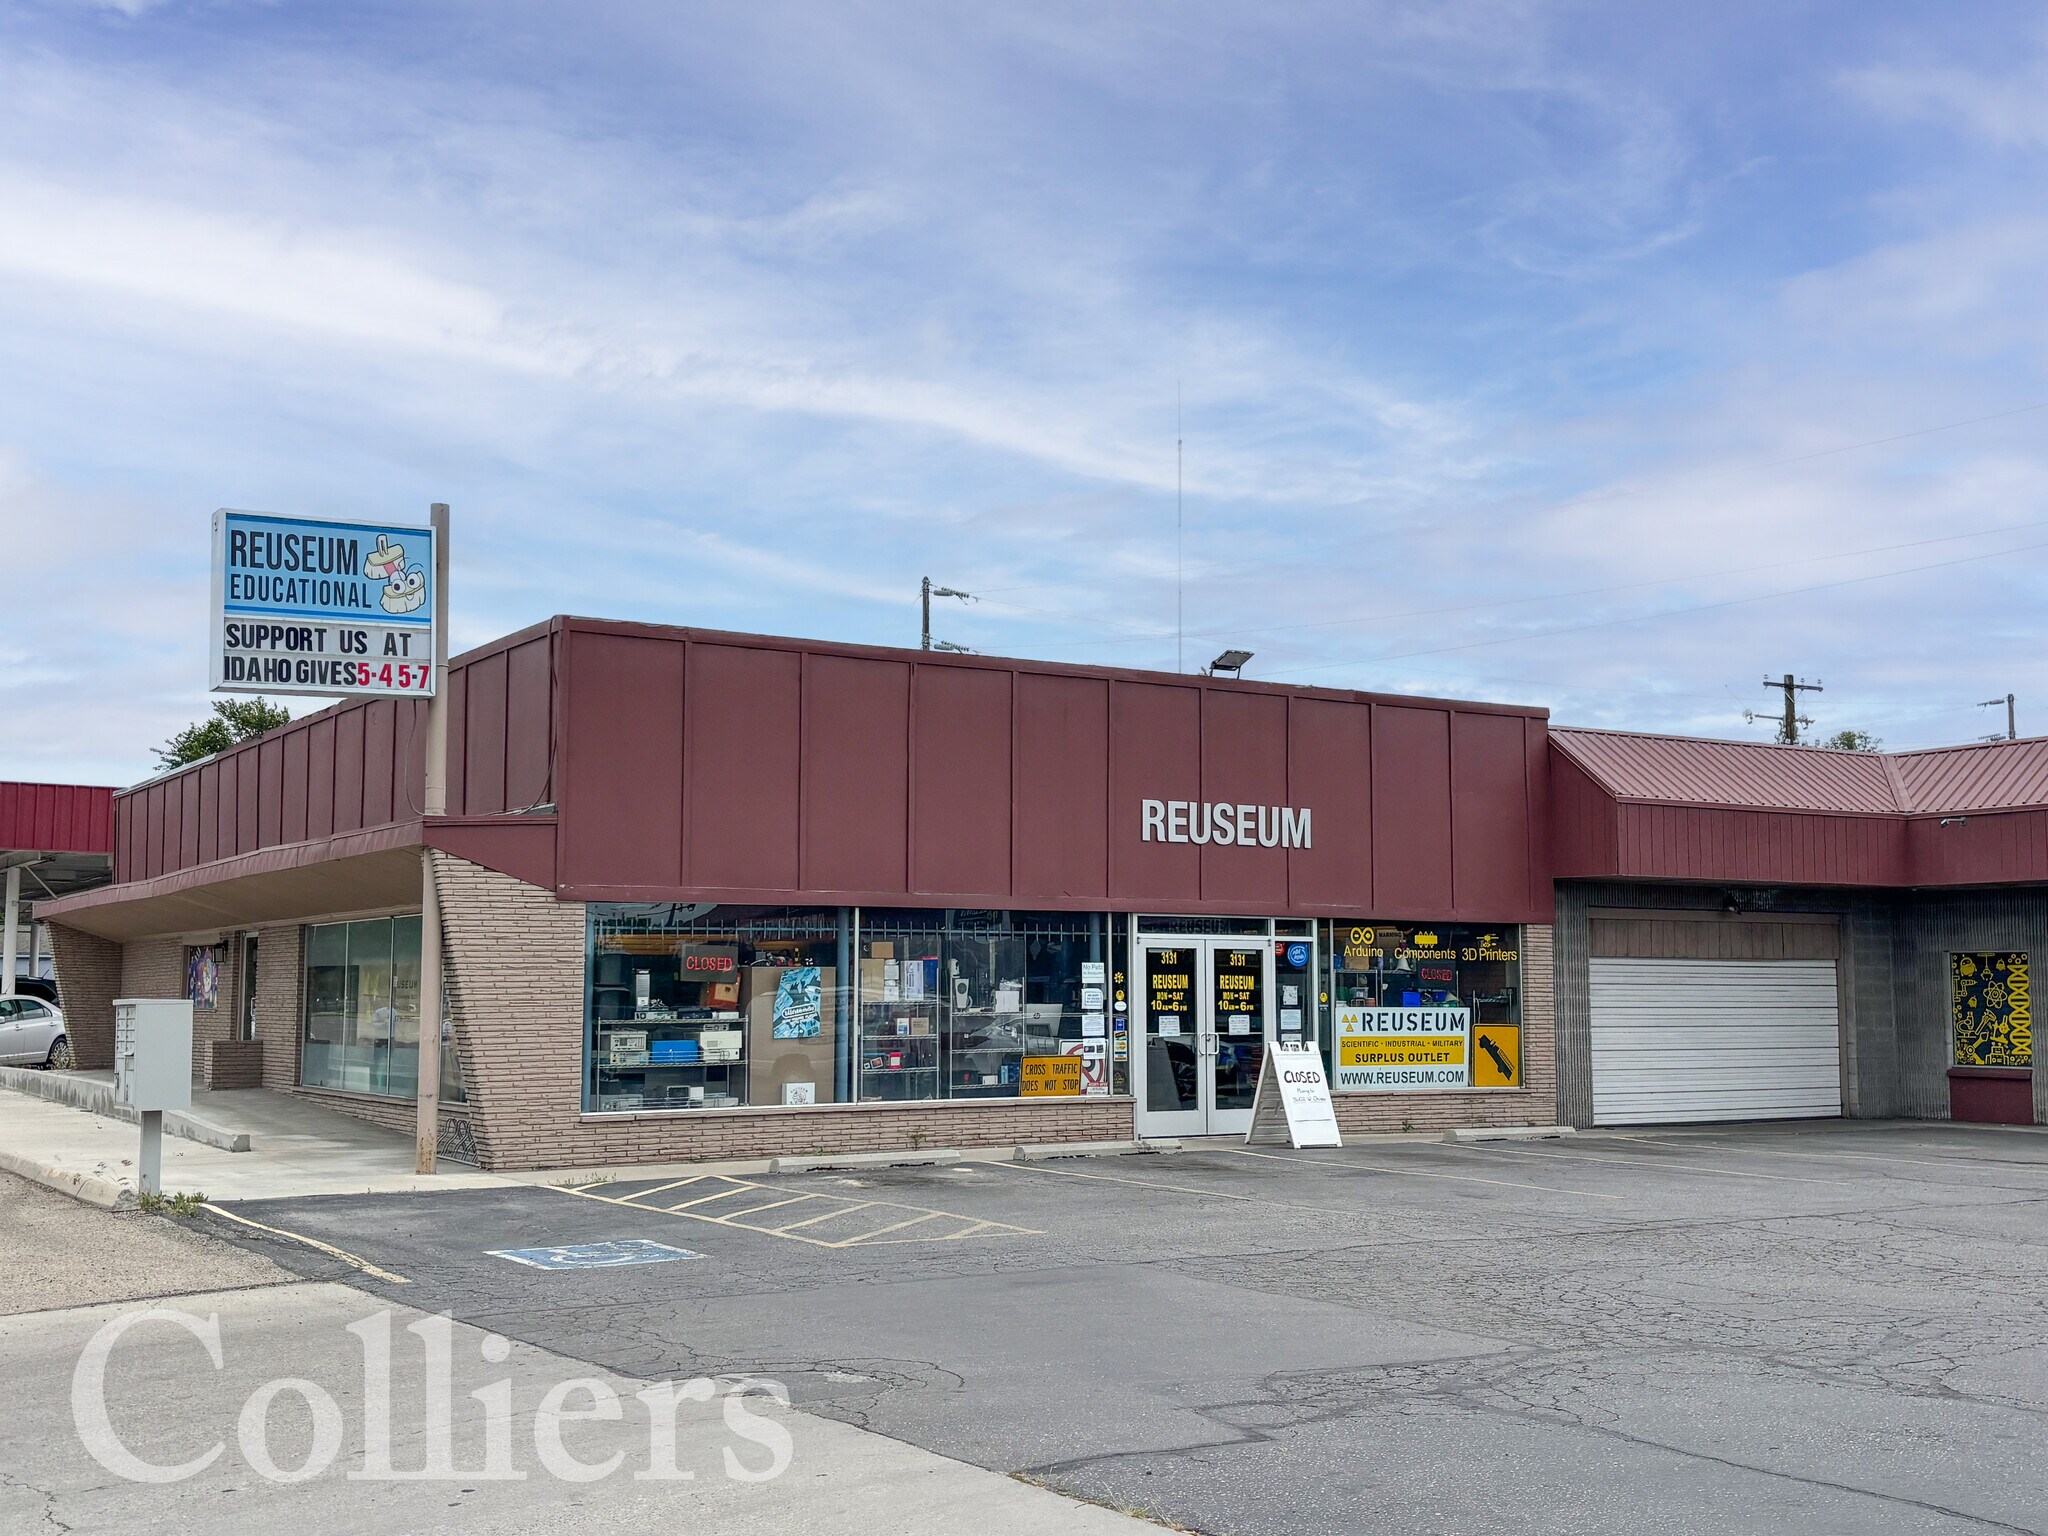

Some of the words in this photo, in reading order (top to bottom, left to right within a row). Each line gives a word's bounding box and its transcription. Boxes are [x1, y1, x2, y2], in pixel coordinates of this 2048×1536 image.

[230, 529, 358, 576] REUSEUM
[230, 573, 372, 609] EDUCATIONAL
[226, 623, 327, 652] SUPPORT
[339, 629, 368, 654] US
[383, 632, 412, 657] AT
[224, 655, 292, 684] IDAHO
[296, 659, 357, 686] GIVES
[1142, 799, 1312, 849] REUSEUM
[1161, 952, 1177, 965] 3131
[1343, 945, 1384, 958] Arduino
[1394, 947, 1457, 962] Components
[1461, 948, 1477, 961] 3D
[1479, 948, 1518, 961] Printers
[686, 955, 734, 973] CLOSED
[1229, 954, 1246, 966] 3131
[1152, 974, 1189, 990] REUSEUM
[1219, 974, 1255, 990] REUSEUM
[1421, 968, 1453, 982] CLOSED
[1361, 1011, 1465, 1032] REUSEUM
[1341, 1040, 1379, 1048] SCIENTIFIC
[1384, 1040, 1426, 1048] INDUSTRIAL
[1432, 1039, 1463, 1047] MILITARY
[1355, 1053, 1404, 1063] SURPLUS
[1408, 1052, 1450, 1062] OUTLET
[1025, 1063, 1046, 1075] CROSS
[1051, 1062, 1078, 1074] TRAFFIC
[1284, 1070, 1321, 1083] CLOSED
[1340, 1070, 1464, 1085] WWW.REUSEUM.COM
[1022, 1080, 1039, 1092] DOES
[1044, 1079, 1057, 1091] NOT
[1062, 1078, 1079, 1091] STOP
